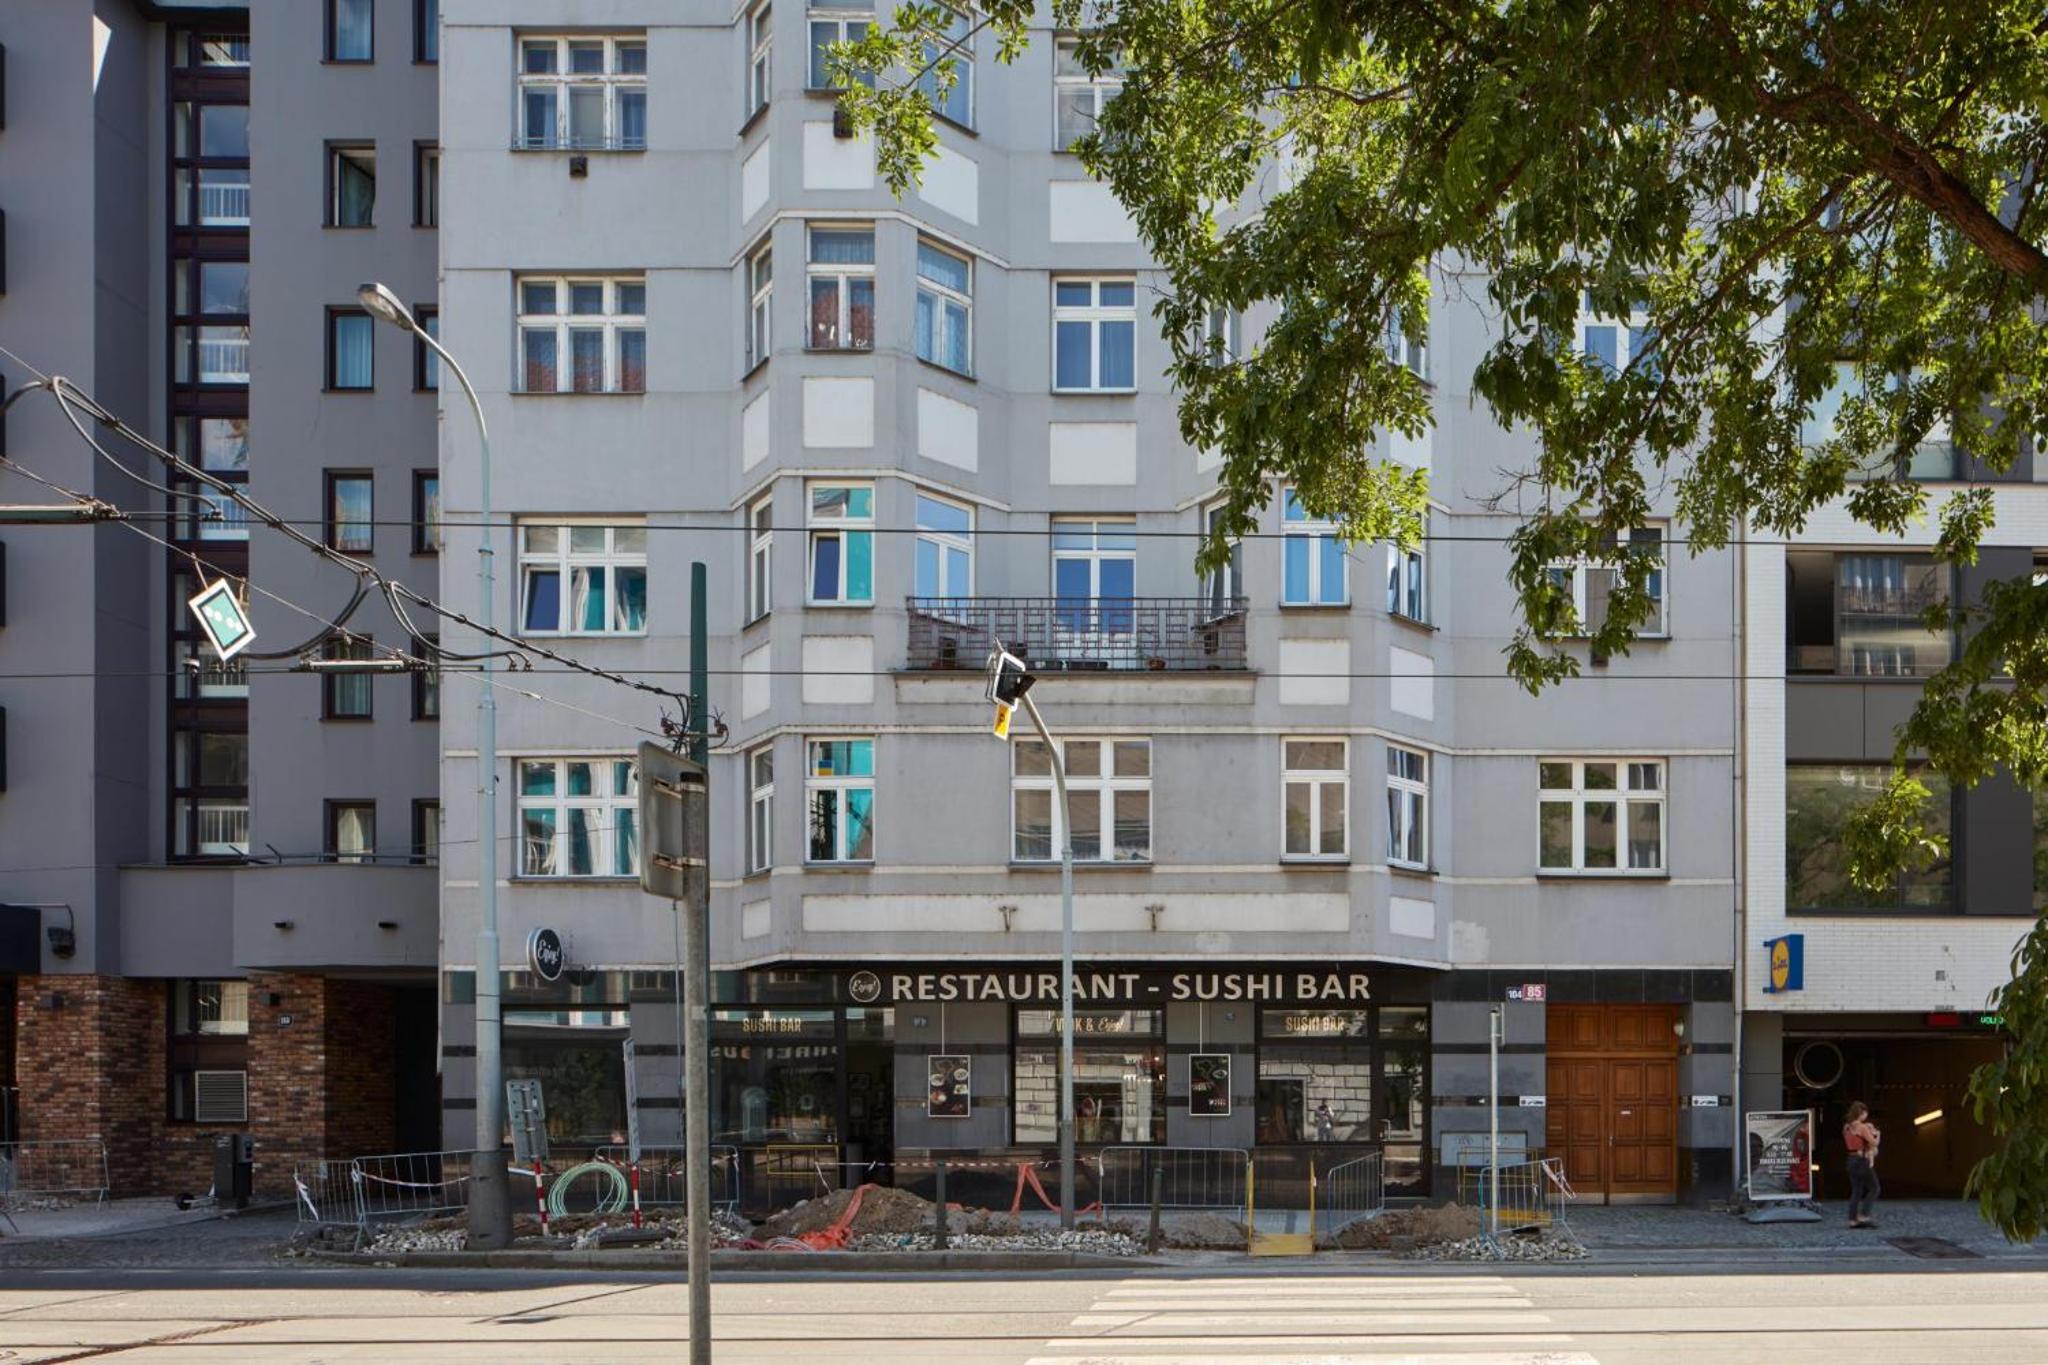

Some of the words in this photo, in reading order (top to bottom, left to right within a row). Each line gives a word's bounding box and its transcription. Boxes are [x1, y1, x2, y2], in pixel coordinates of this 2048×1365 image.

[892, 973, 1141, 1001] RESTAURANT
[1171, 973, 1284, 1001] SUSHI
[1296, 973, 1371, 1000] BAR
[1527, 986, 1542, 998] 85
[742, 1017, 777, 1033] SUSHI
[779, 1017, 802, 1033] BAR
[1056, 1017, 1083, 1033] WK
[1285, 1015, 1320, 1032] SUSHI
[1322, 1015, 1345, 1032] BAR
